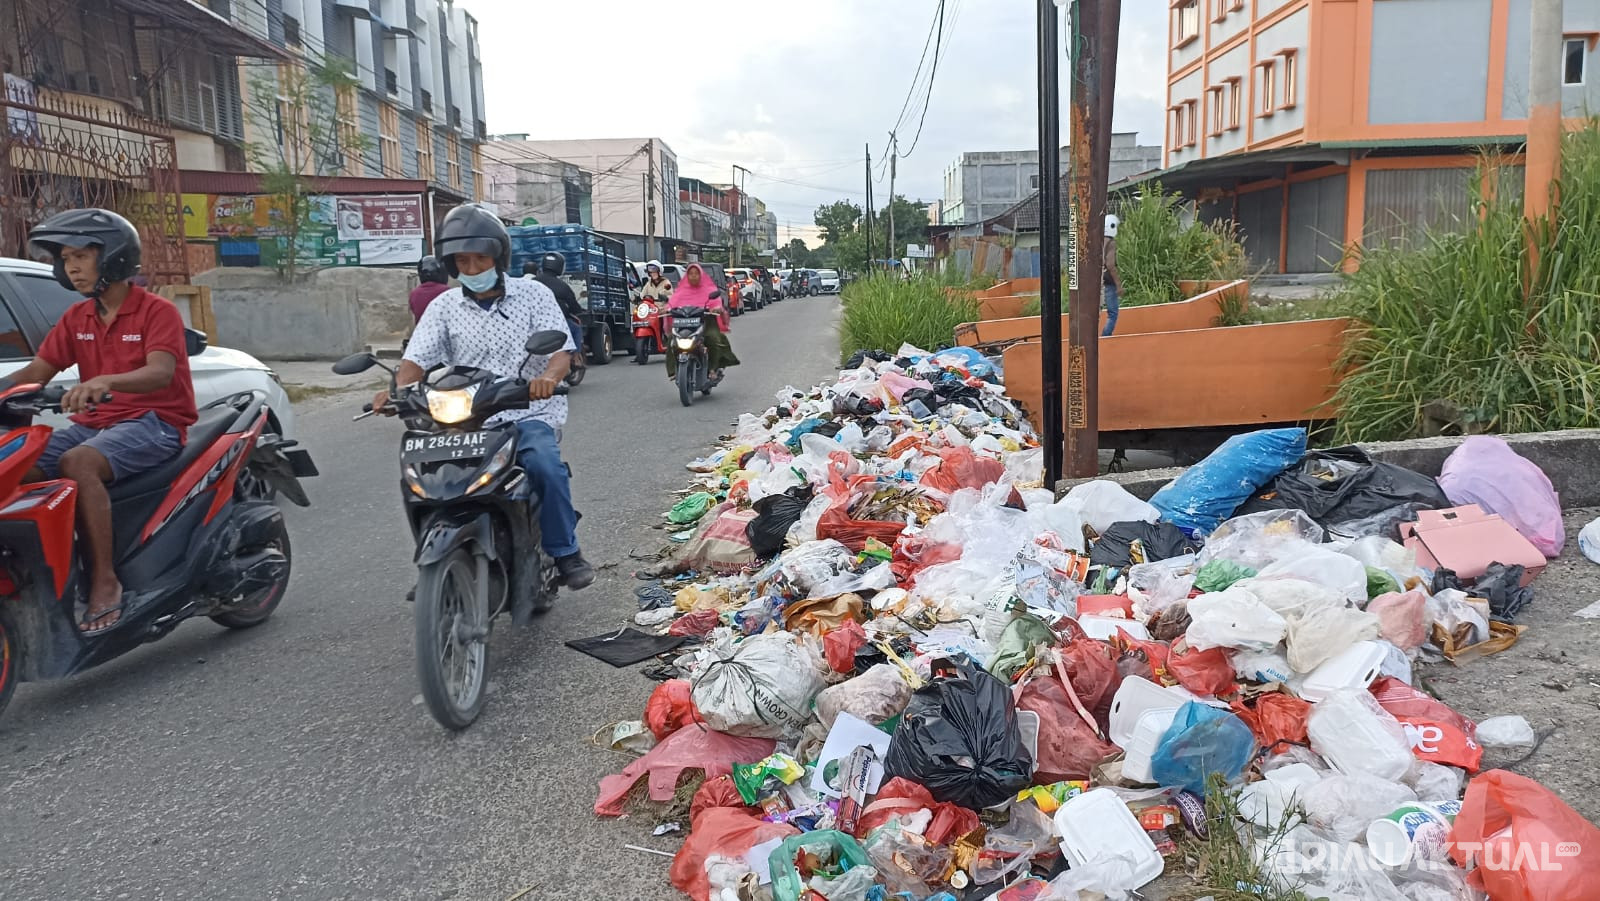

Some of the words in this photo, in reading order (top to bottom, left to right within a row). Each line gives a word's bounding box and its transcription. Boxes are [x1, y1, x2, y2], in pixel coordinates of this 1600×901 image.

[405, 439, 425, 451] BM
[428, 435, 461, 449] 2845
[463, 432, 487, 446] AAF
